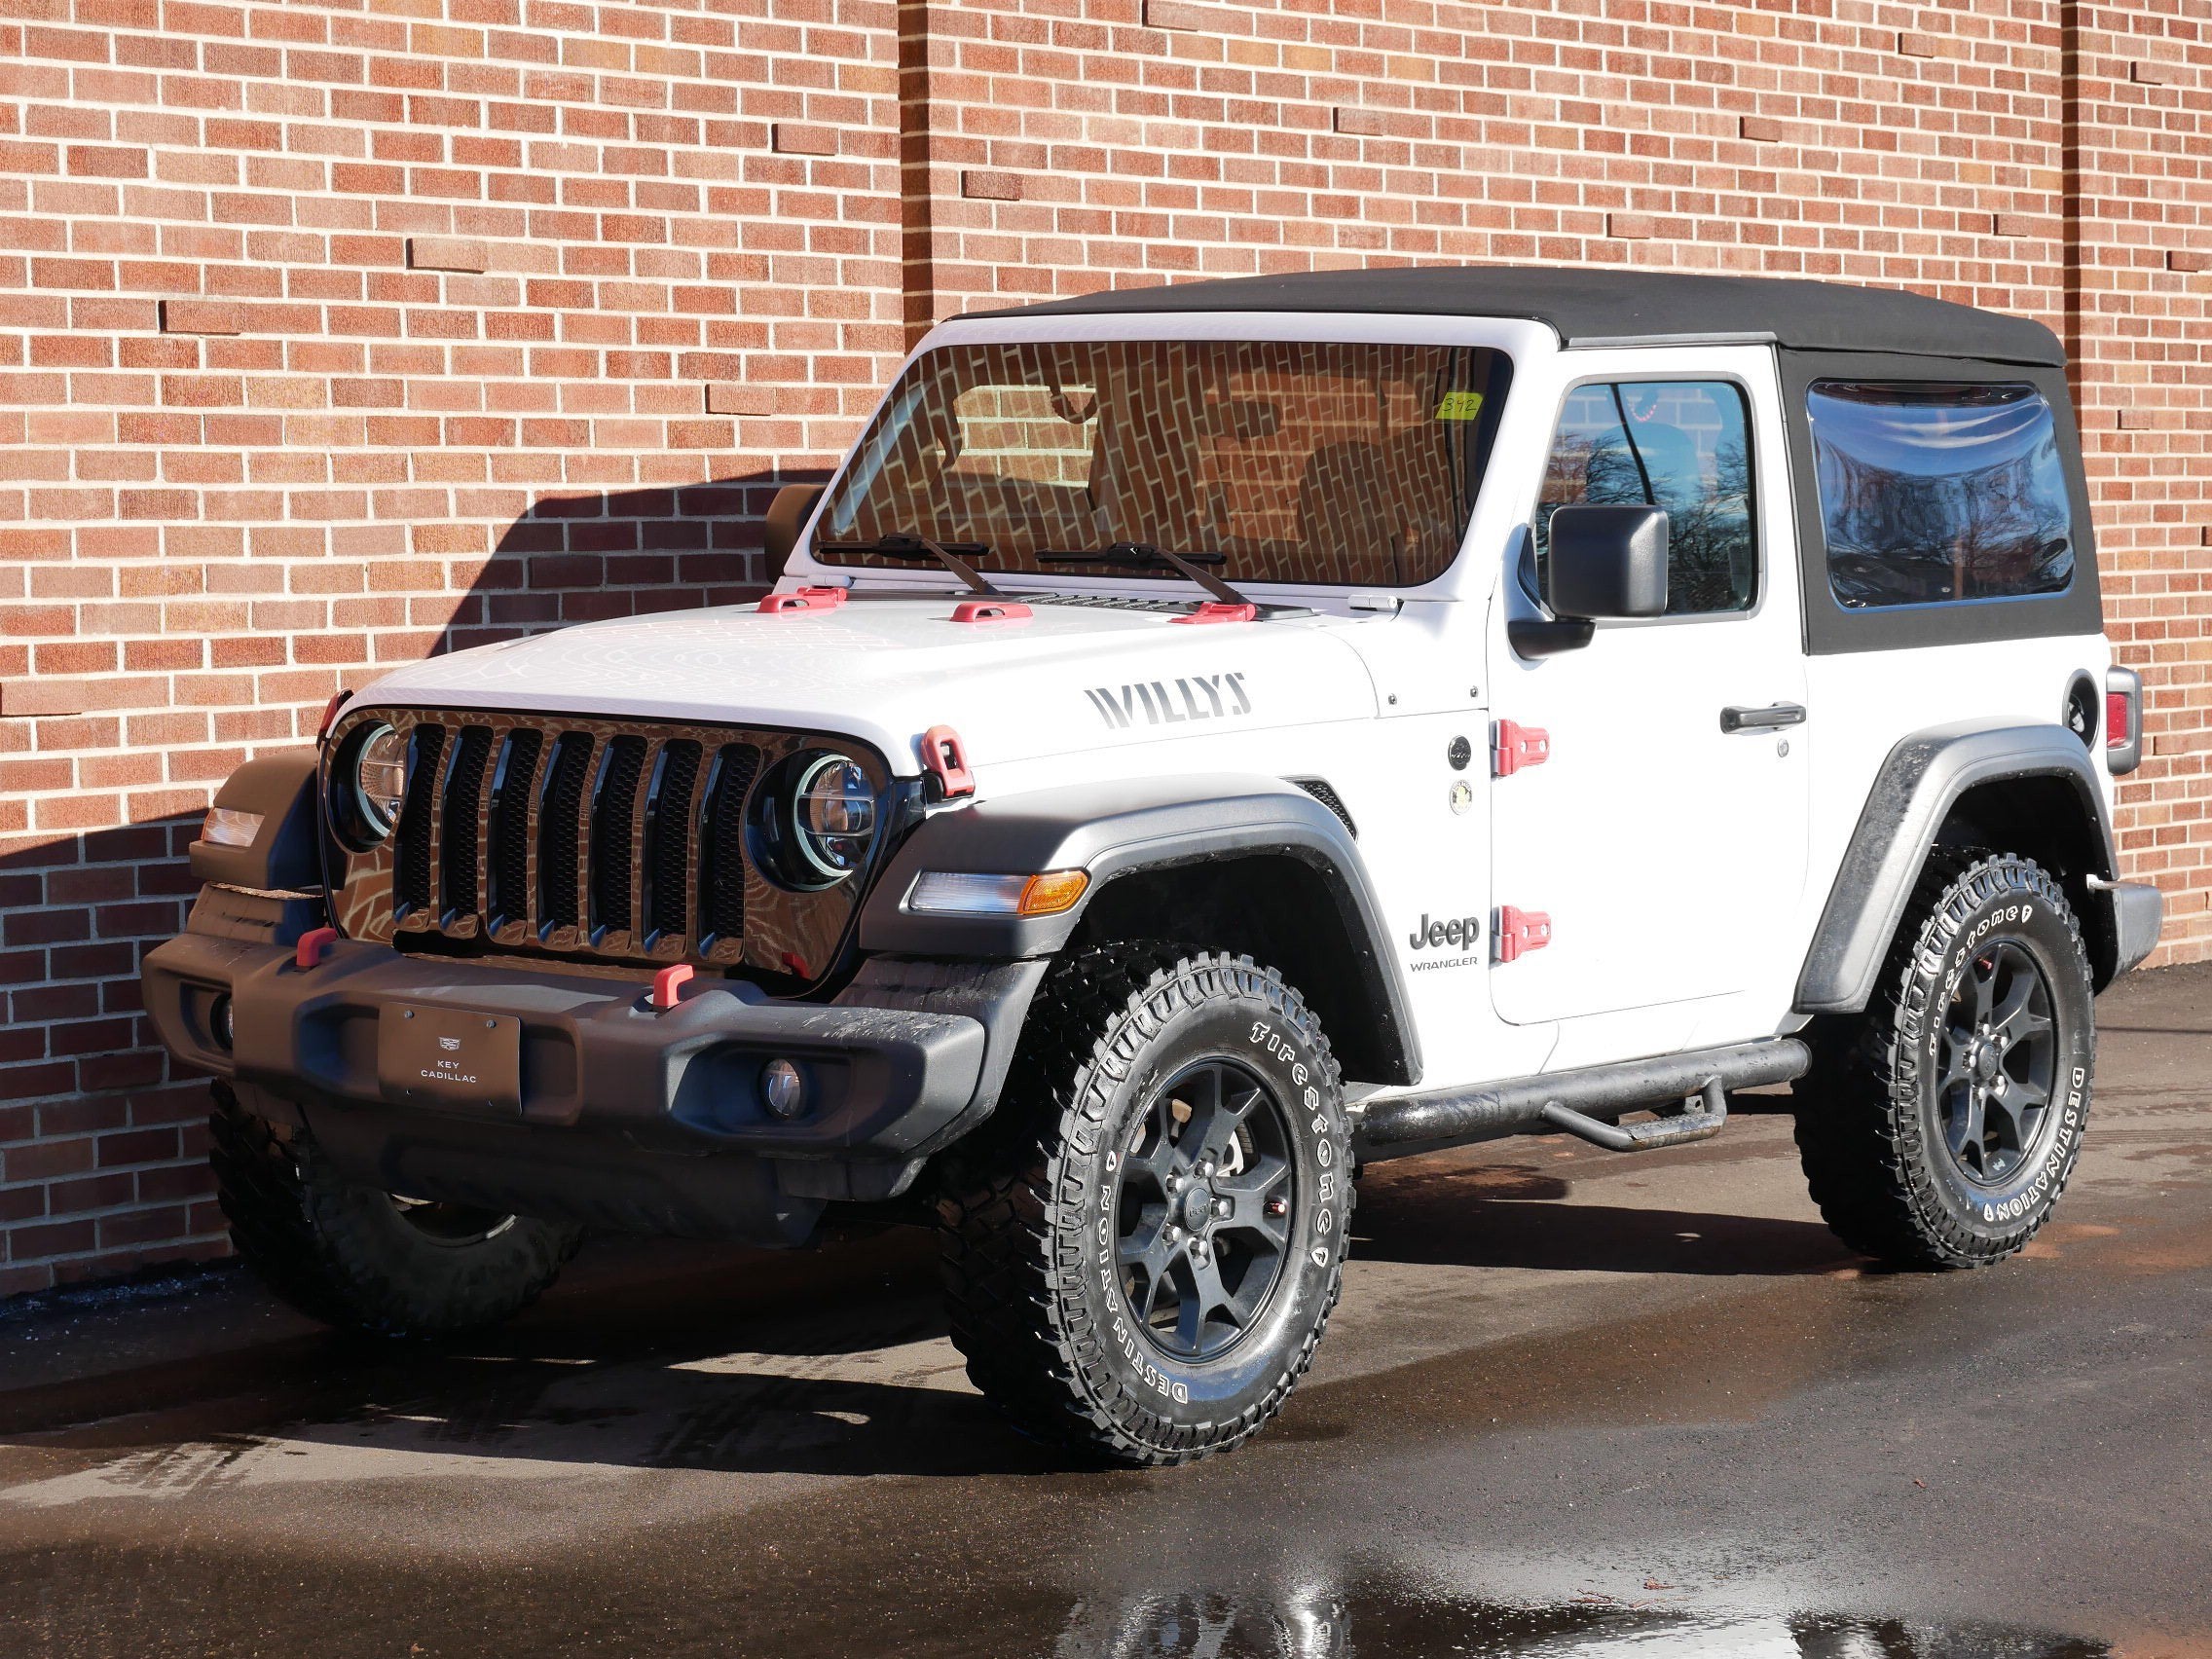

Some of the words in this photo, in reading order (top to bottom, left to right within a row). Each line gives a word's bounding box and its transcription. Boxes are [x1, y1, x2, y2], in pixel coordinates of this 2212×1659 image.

[1443, 397, 1477, 412] 342
[1083, 672, 1252, 730] WILLYS
[1409, 913, 1480, 951] Jeep
[1410, 956, 1478, 973] WRANGLER
[421, 1069, 477, 1083] CADILLAC
[437, 1060, 460, 1069] KEY
[1249, 1021, 1334, 1236] Firestone
[1996, 1067, 2085, 1222] DESTINATION
[1098, 1185, 1189, 1405] DESTINATION
